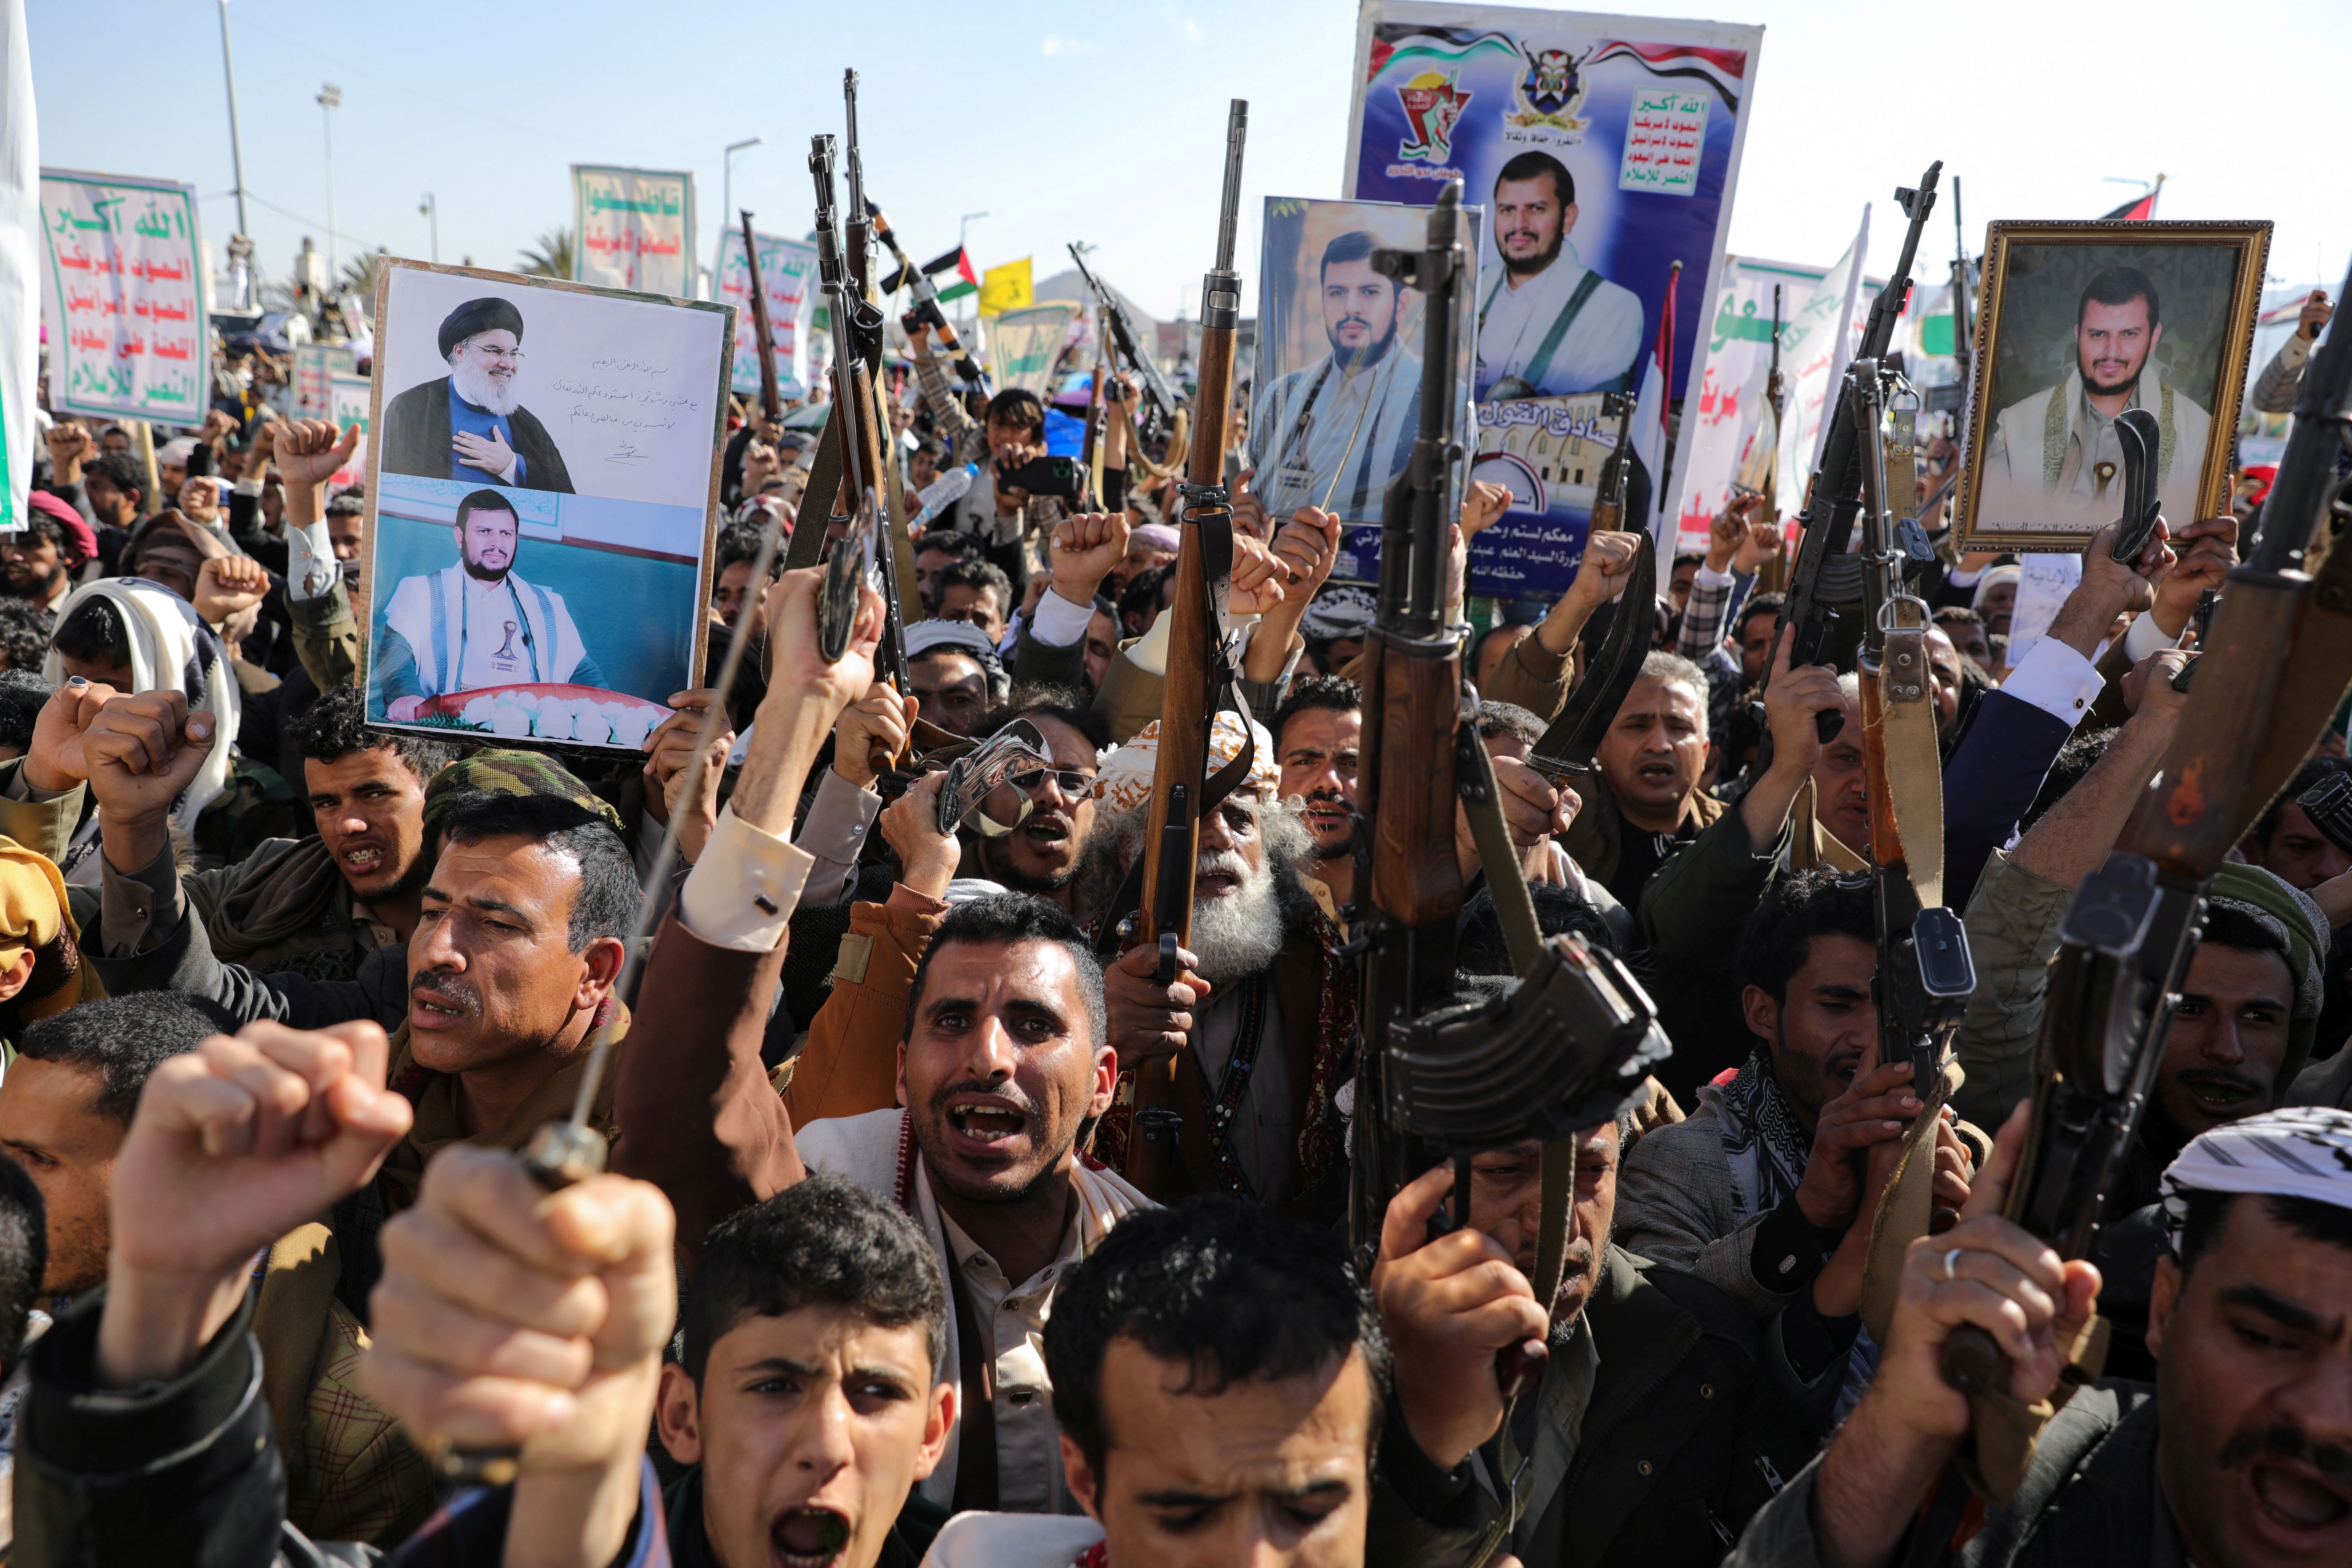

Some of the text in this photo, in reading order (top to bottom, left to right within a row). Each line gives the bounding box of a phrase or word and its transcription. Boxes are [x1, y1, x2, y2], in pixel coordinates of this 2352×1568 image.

[1637, 93, 1705, 113] الله أكبر
[1672, 121, 1701, 133] الموت
[1669, 138, 1699, 150] الموت
[1661, 170, 1693, 186] النصر
[50, 192, 186, 239] الله أكبر
[131, 257, 192, 283] الموت
[133, 296, 195, 324] الموت
[638, 360, 652, 372] الله
[139, 369, 195, 408] النصر
[1478, 399, 1619, 449] صادق القول
[1541, 527, 1574, 543] معكم
